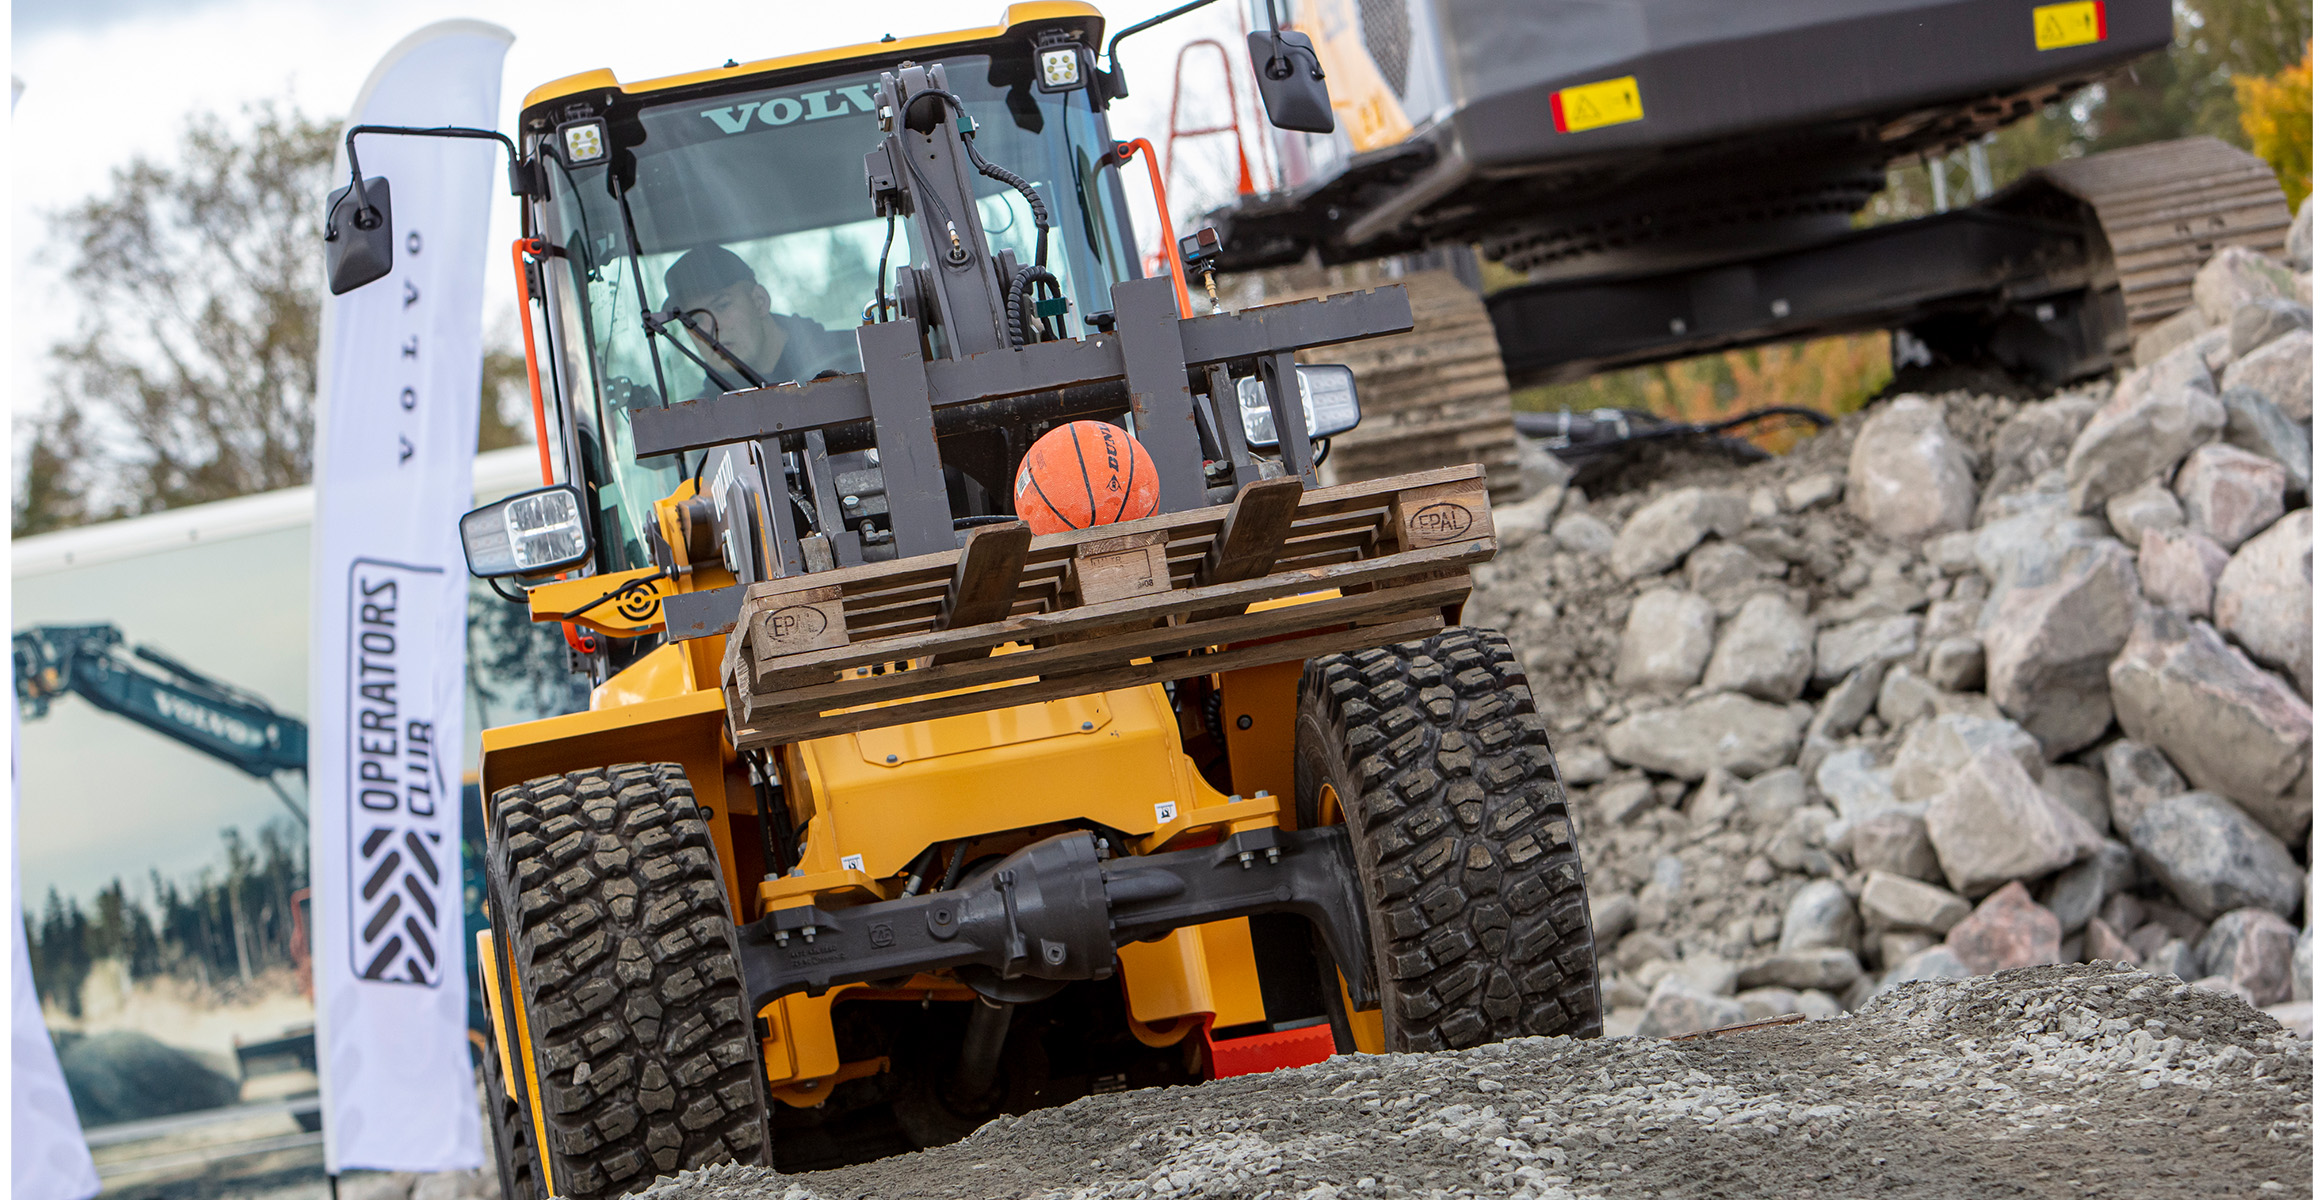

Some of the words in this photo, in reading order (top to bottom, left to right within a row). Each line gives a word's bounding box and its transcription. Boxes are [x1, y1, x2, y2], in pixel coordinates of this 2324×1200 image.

[700, 83, 882, 135] VOLV
[399, 230, 423, 469] VOLVO
[1096, 422, 1119, 473] DUNL
[1418, 511, 1464, 534] EPAL
[360, 577, 398, 812] OPERATORS
